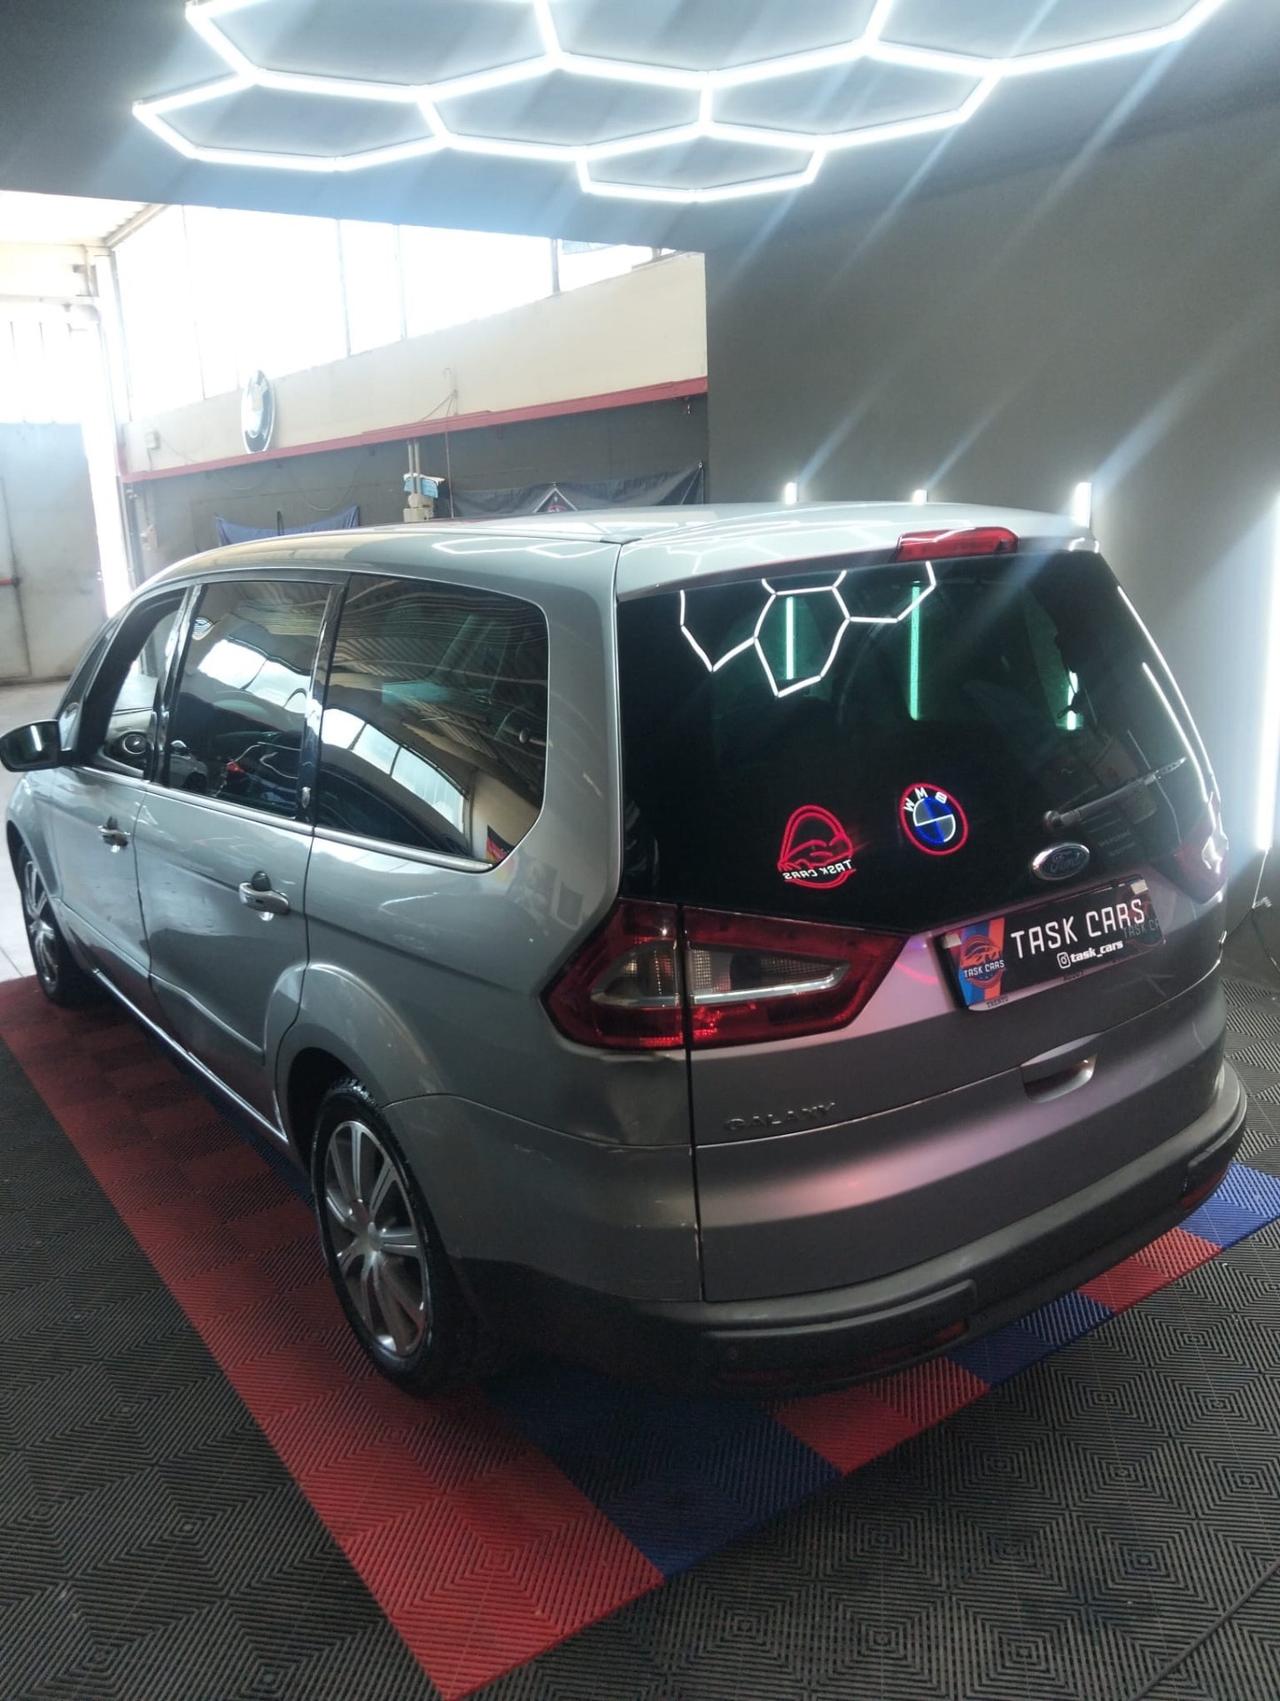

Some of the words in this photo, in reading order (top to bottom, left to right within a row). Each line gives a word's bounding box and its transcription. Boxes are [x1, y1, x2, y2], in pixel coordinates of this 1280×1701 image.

[1010, 915, 1078, 958] TASK
[1085, 898, 1145, 938] CARS
[1070, 940, 1124, 962] task_cars
[963, 967, 984, 978] TASK
[984, 959, 1005, 972] CARS
